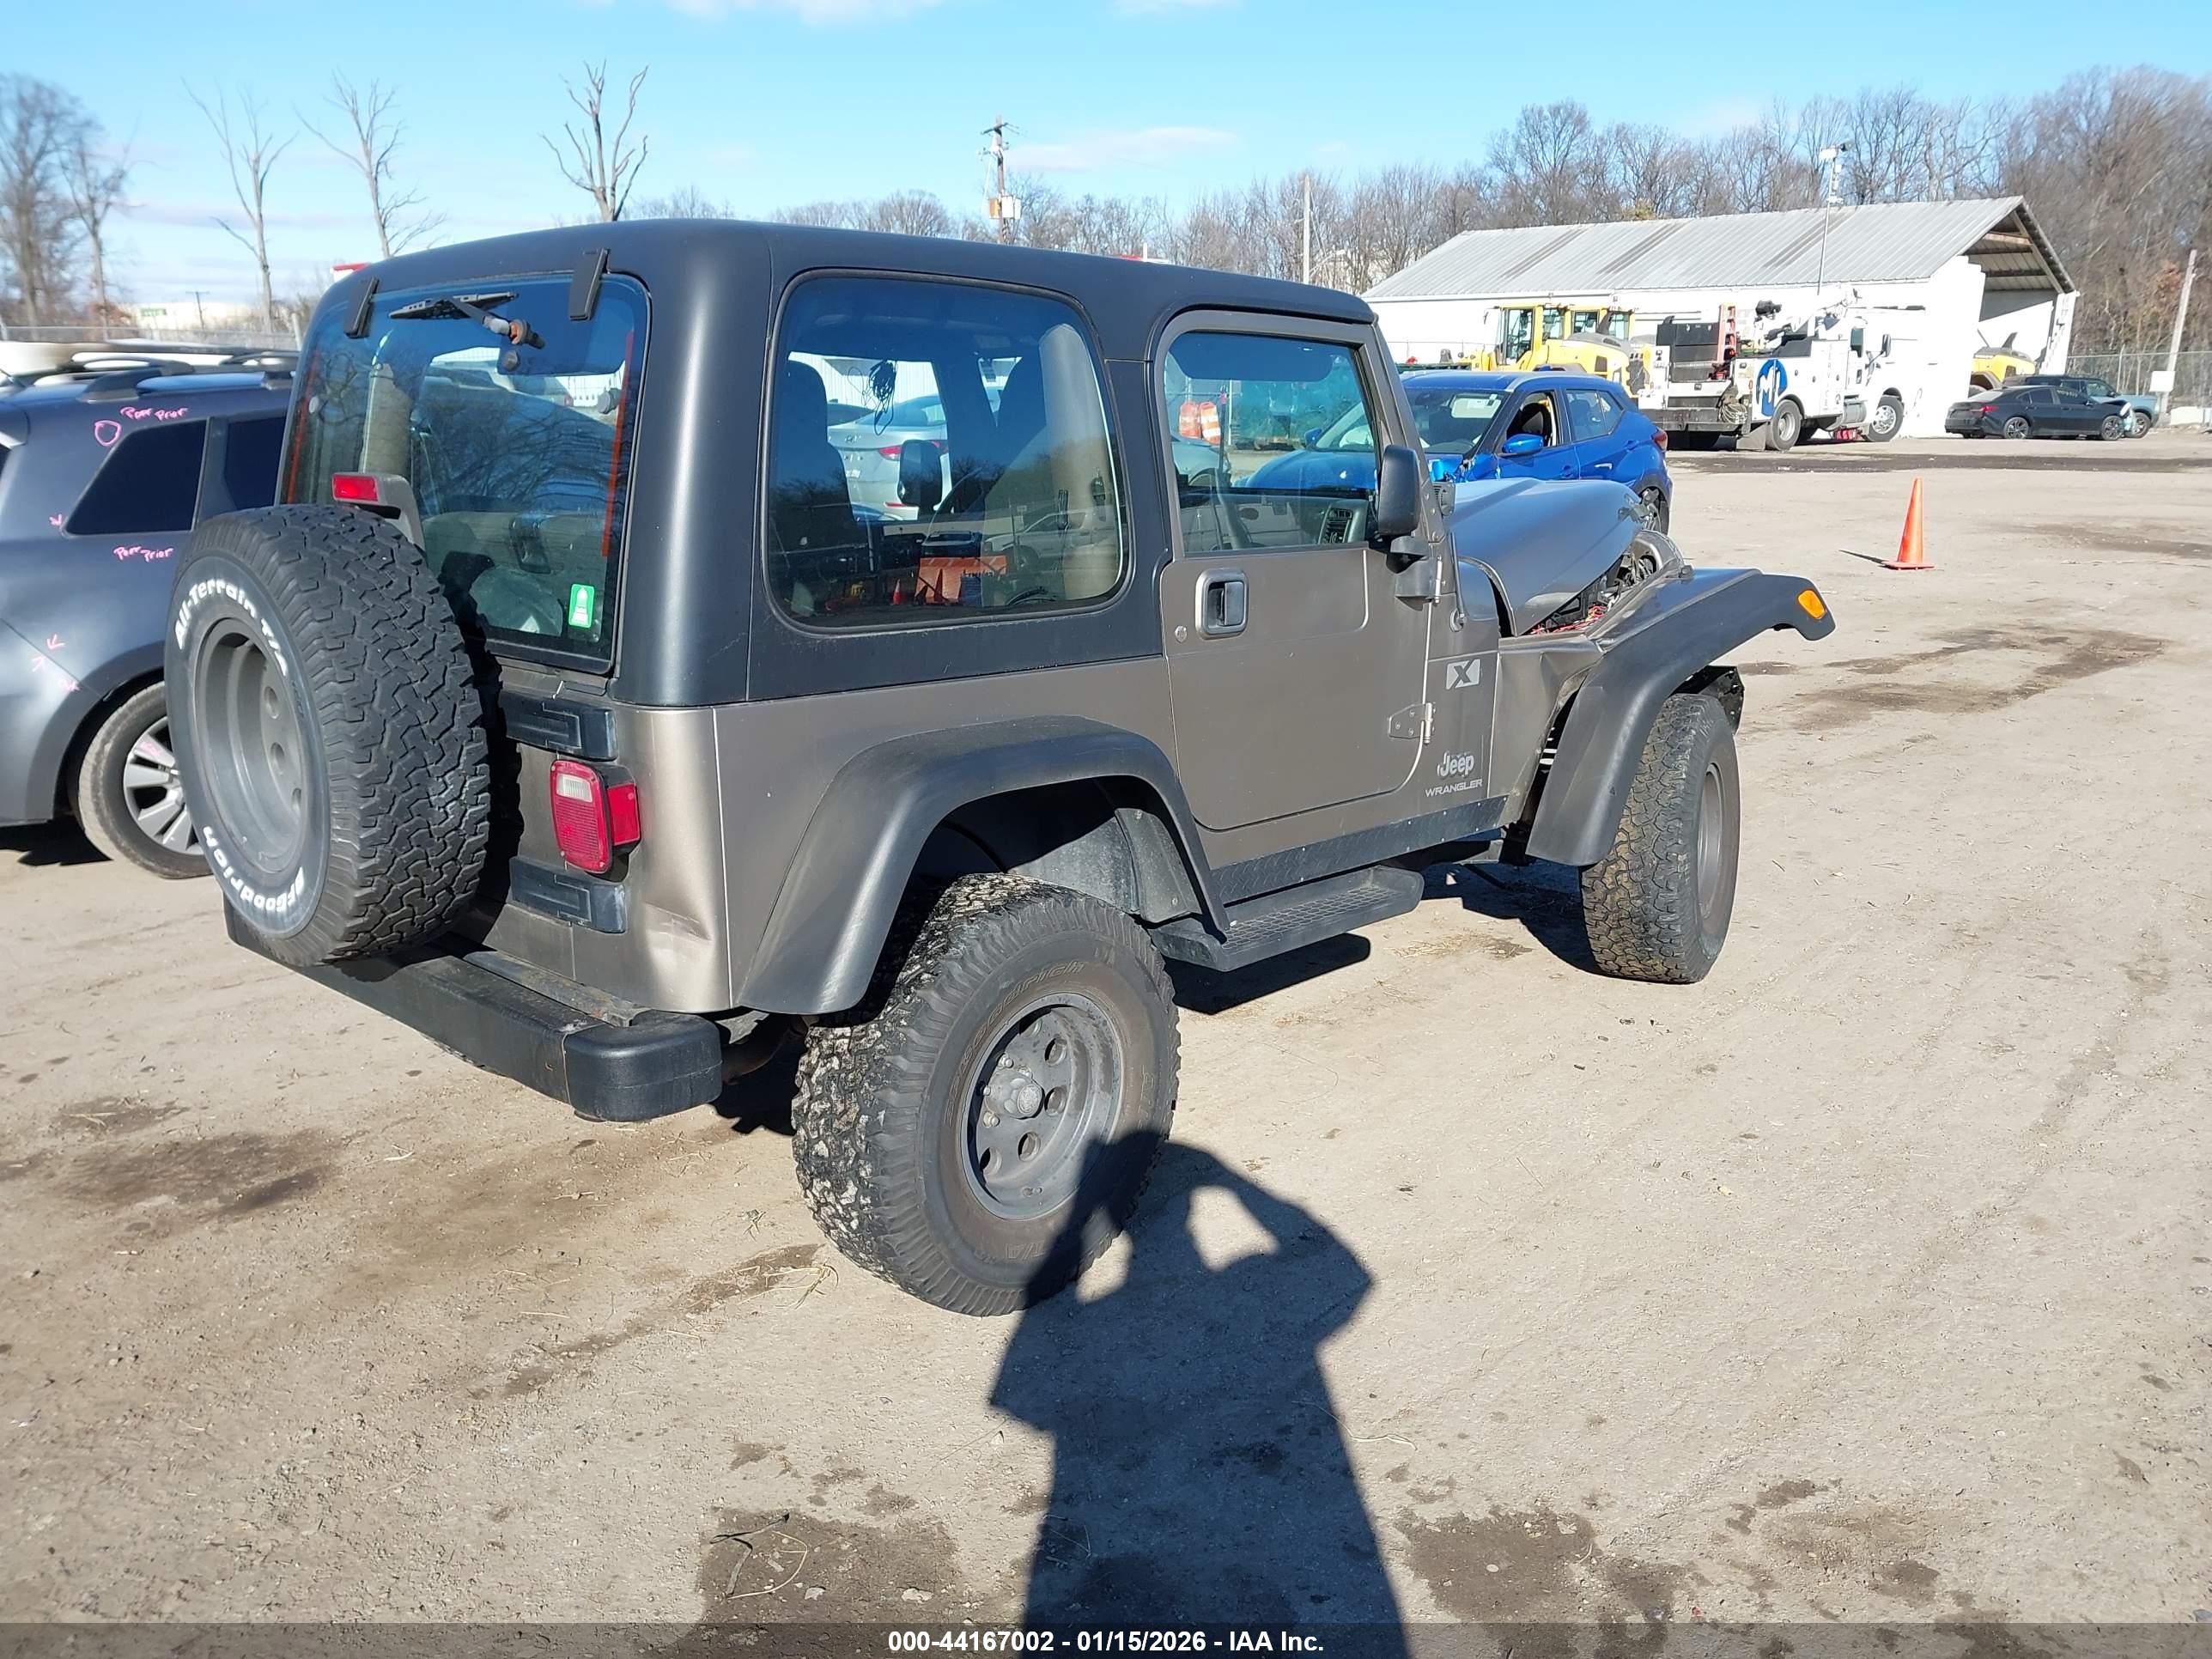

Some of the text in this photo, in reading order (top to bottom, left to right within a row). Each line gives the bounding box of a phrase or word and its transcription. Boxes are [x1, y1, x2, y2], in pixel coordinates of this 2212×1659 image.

[175, 579, 257, 650] All-Terrain
[1437, 751, 1474, 777] Jeep
[1425, 778, 1483, 798] WRANGLER
